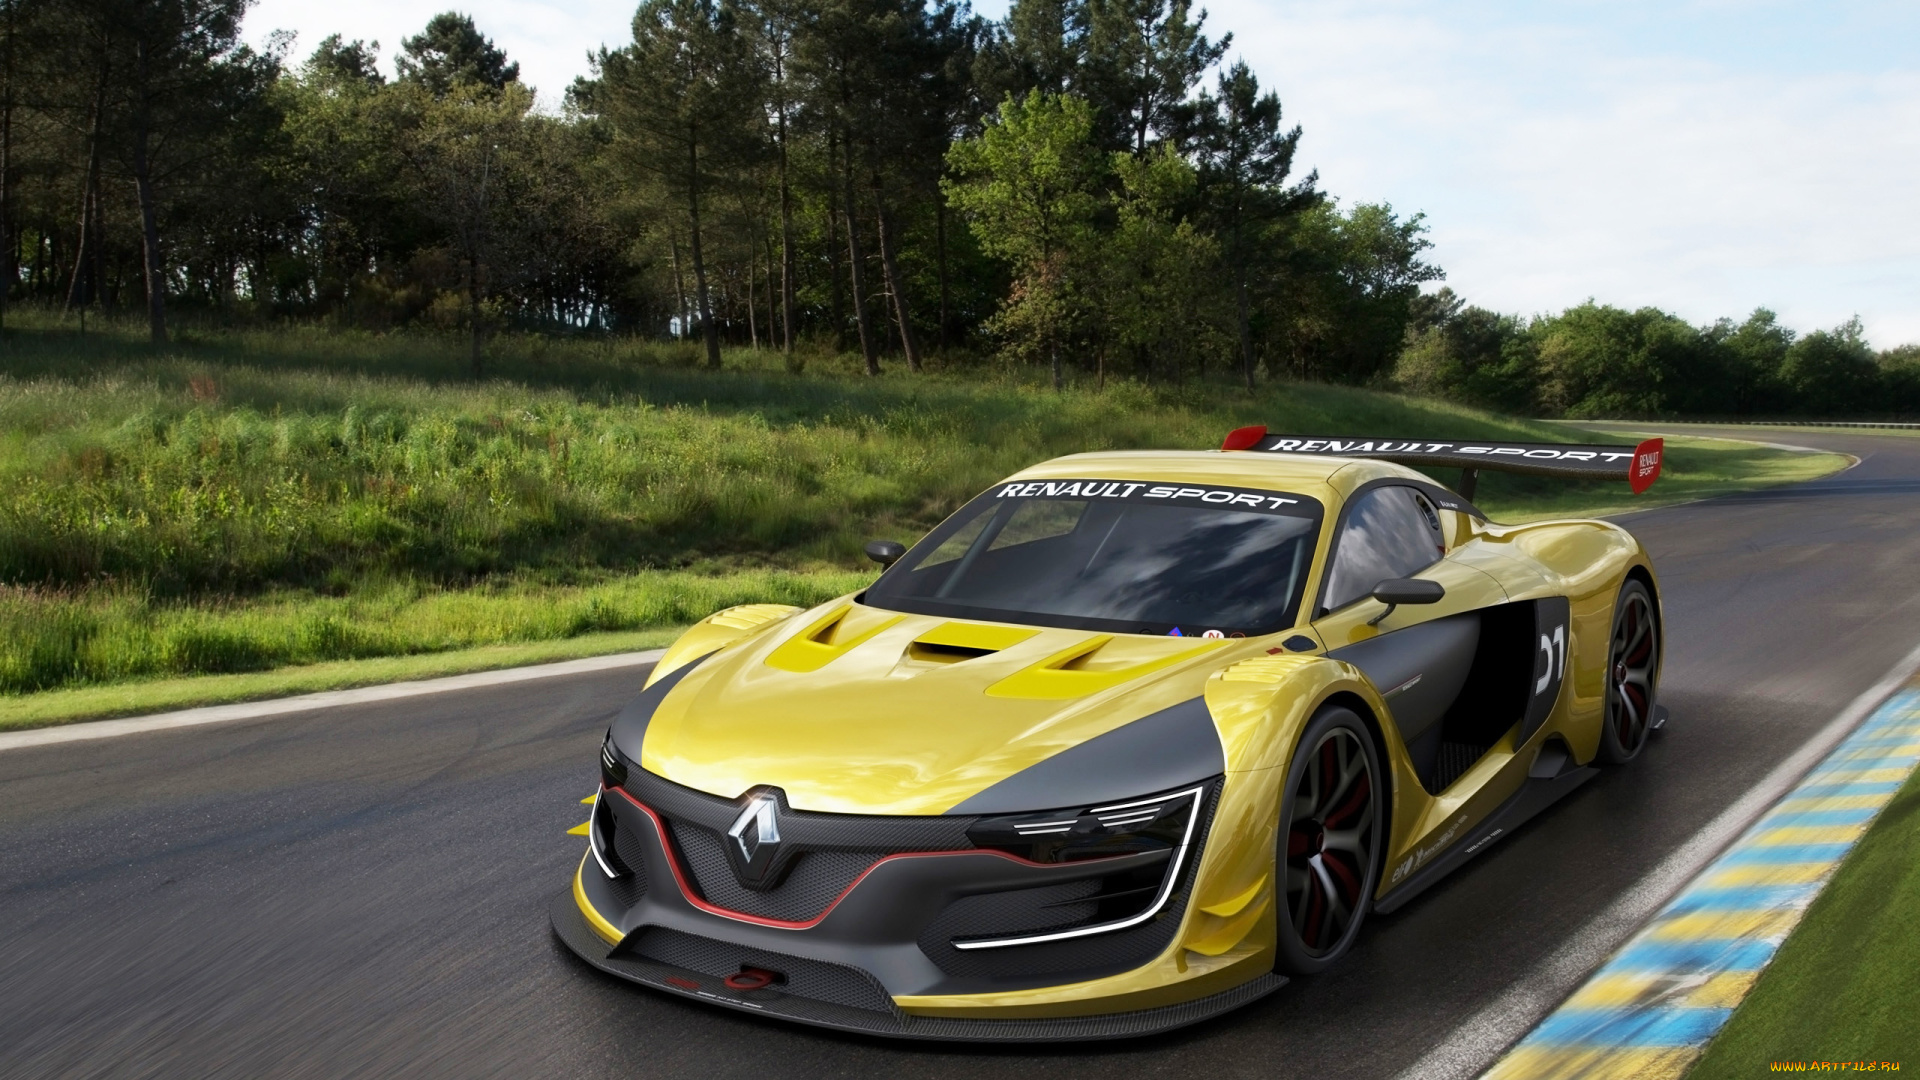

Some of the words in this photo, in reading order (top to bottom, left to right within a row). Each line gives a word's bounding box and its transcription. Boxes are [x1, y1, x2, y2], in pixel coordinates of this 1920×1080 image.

[1269, 439, 1454, 454] RENAULT
[1453, 445, 1635, 463] SPORT
[1639, 451, 1660, 468] RENAULT
[1639, 466, 1655, 477] SPORT
[996, 482, 1146, 498] RENAULT
[1143, 486, 1299, 510] SPORT
